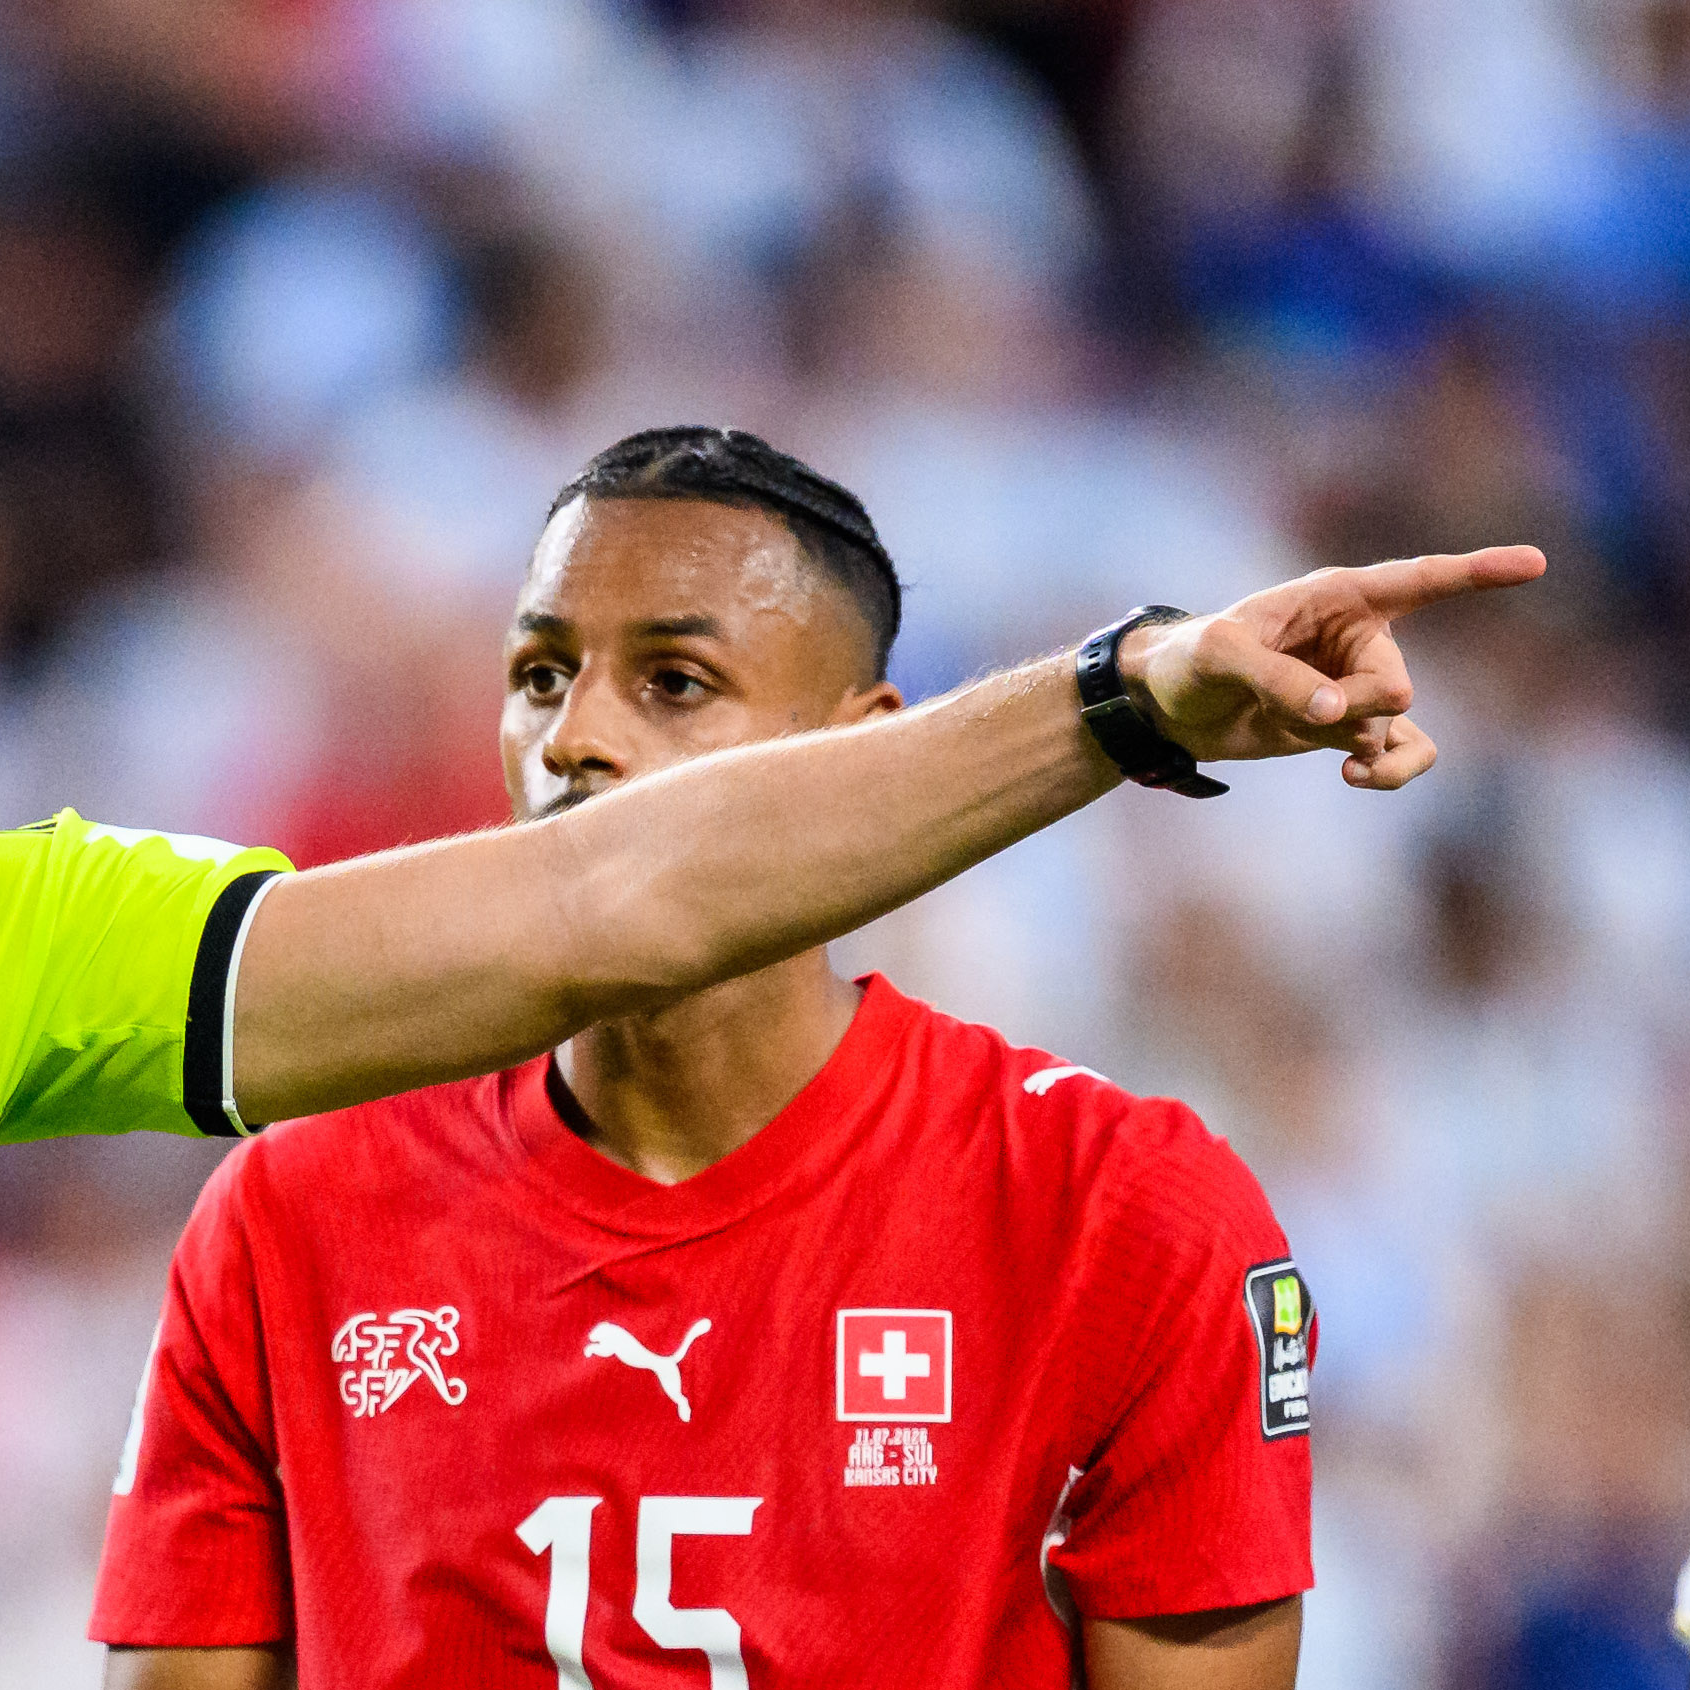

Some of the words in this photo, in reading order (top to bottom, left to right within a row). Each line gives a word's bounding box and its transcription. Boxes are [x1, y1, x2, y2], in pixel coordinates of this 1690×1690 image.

[848, 1443, 885, 1467] ARG
[902, 1441, 933, 1467] SUI
[843, 1465, 901, 1487] KANSAS
[902, 1464, 938, 1486] CITY
